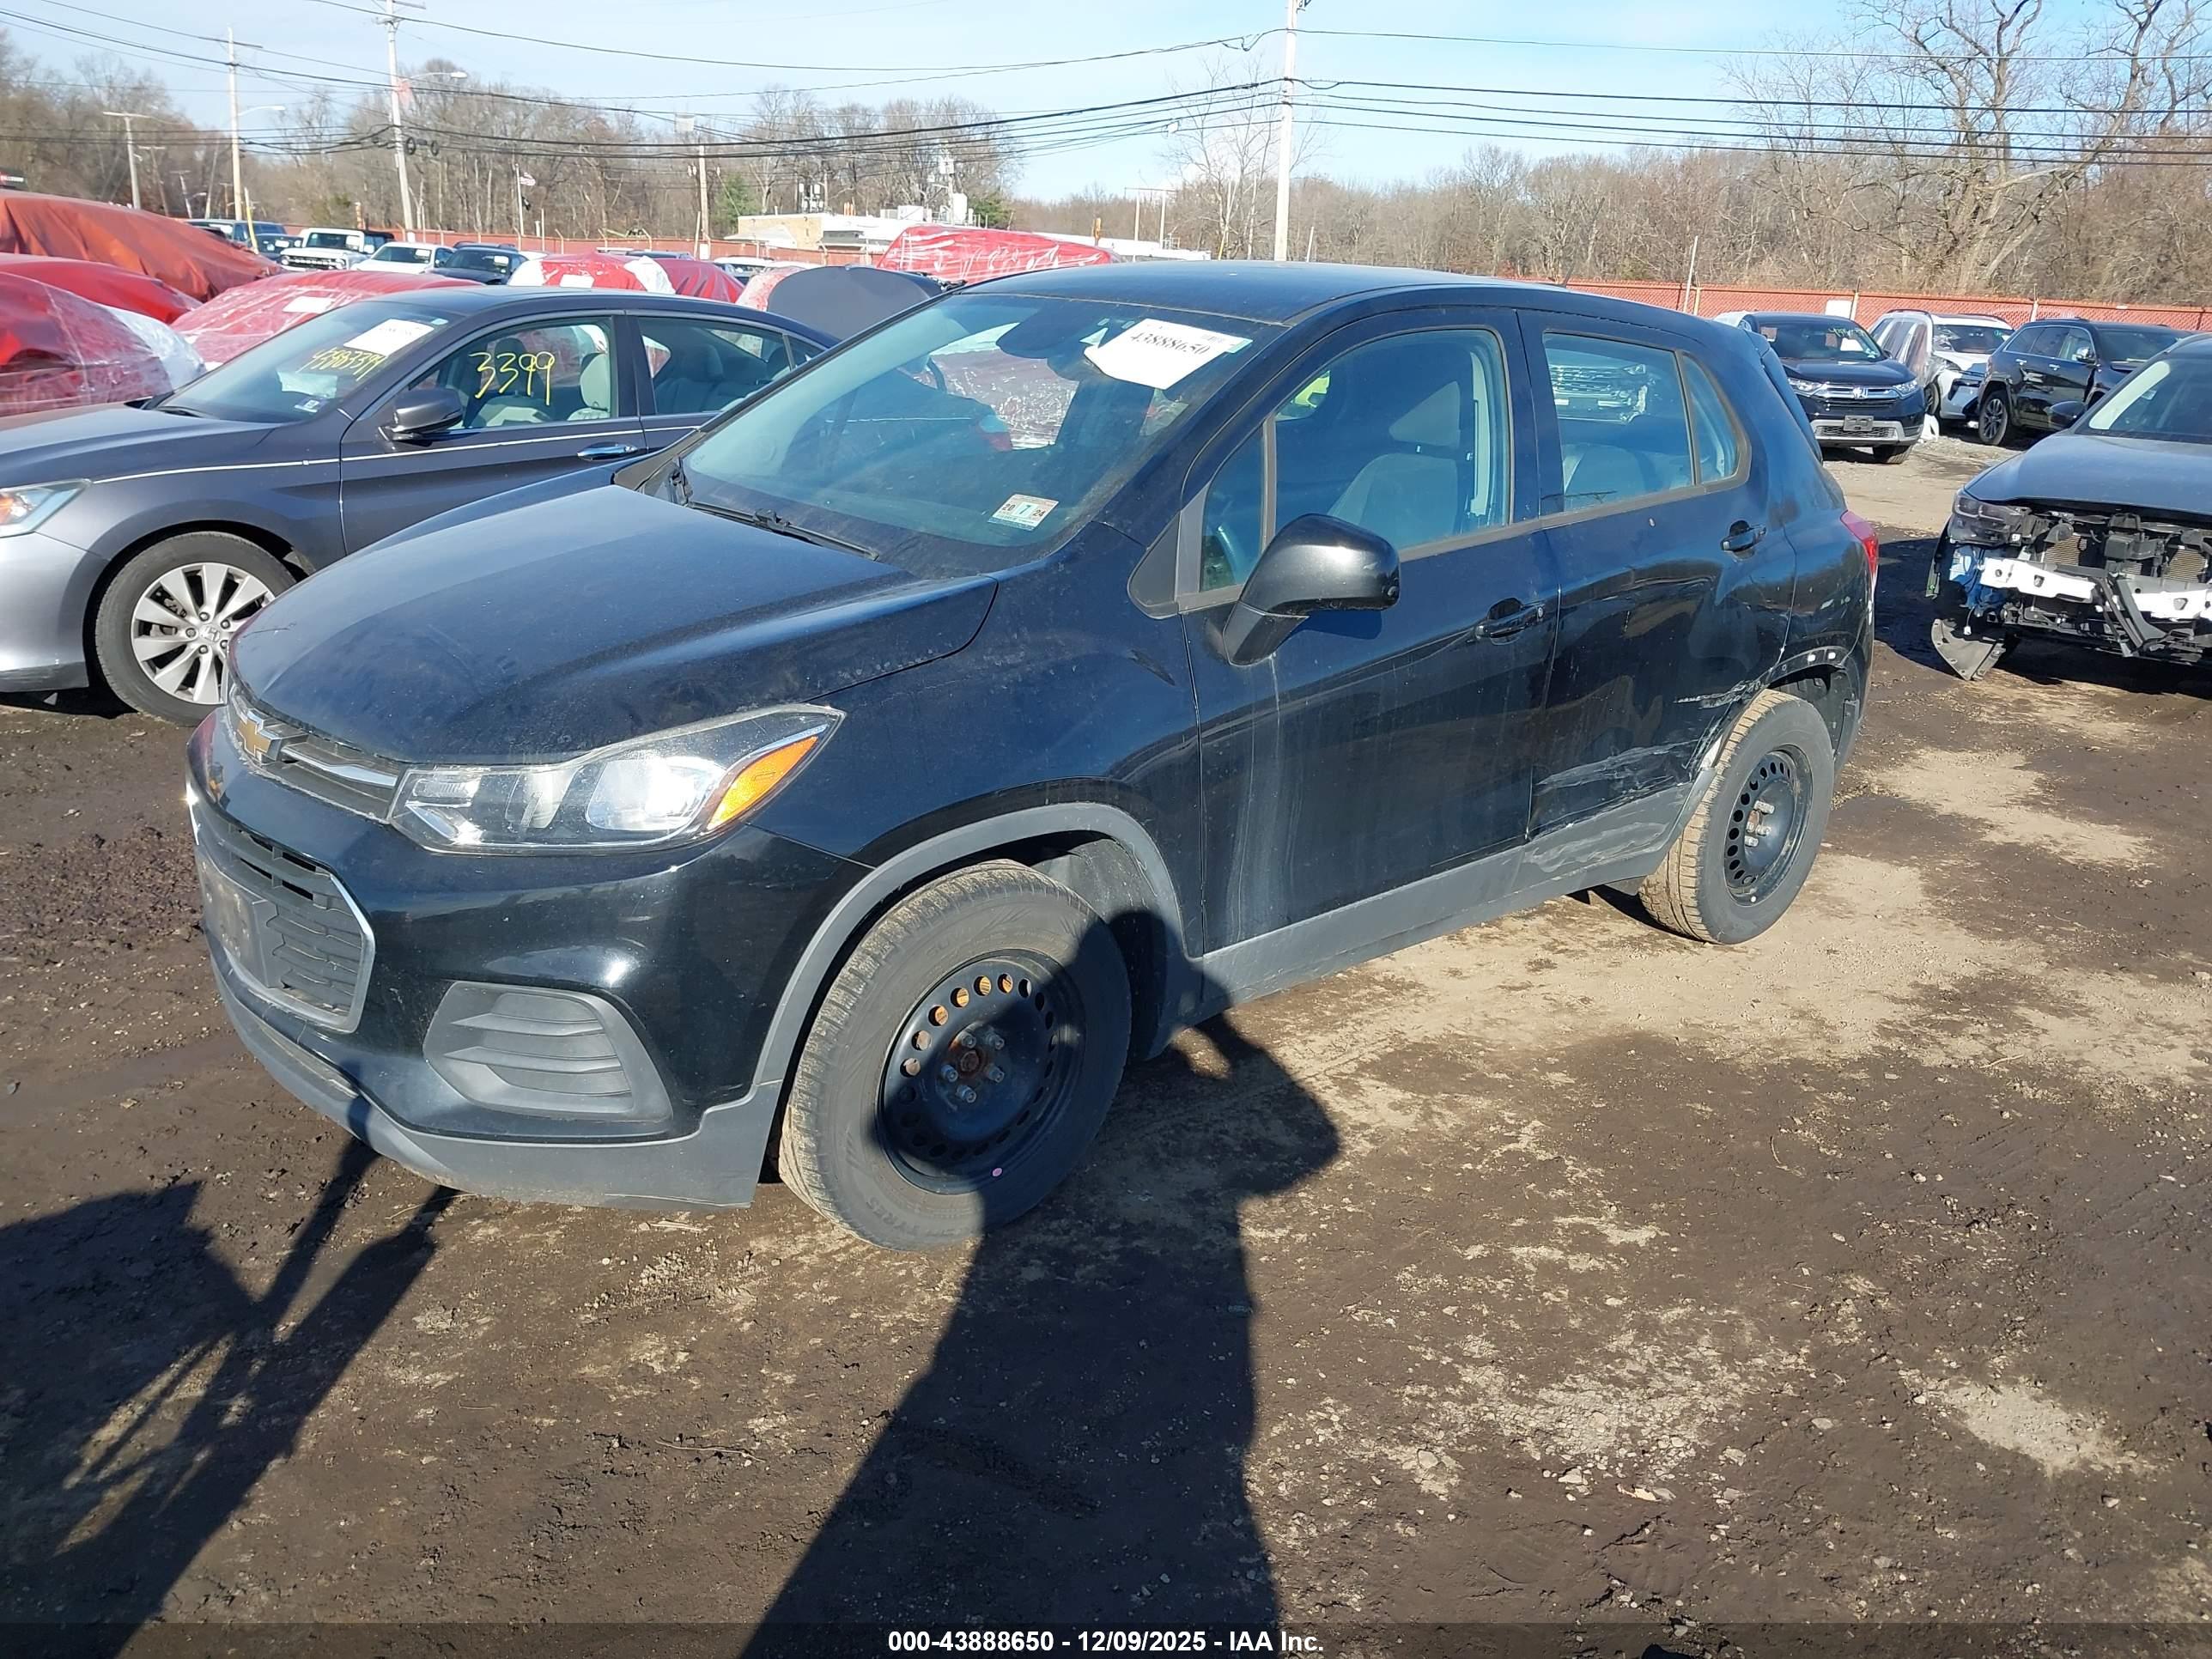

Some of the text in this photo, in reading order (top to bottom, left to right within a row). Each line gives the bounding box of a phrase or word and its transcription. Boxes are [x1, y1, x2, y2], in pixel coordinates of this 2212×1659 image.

[468, 351, 556, 406] 3399
[1001, 503, 1016, 512] 20
[1018, 504, 1031, 515] 7
